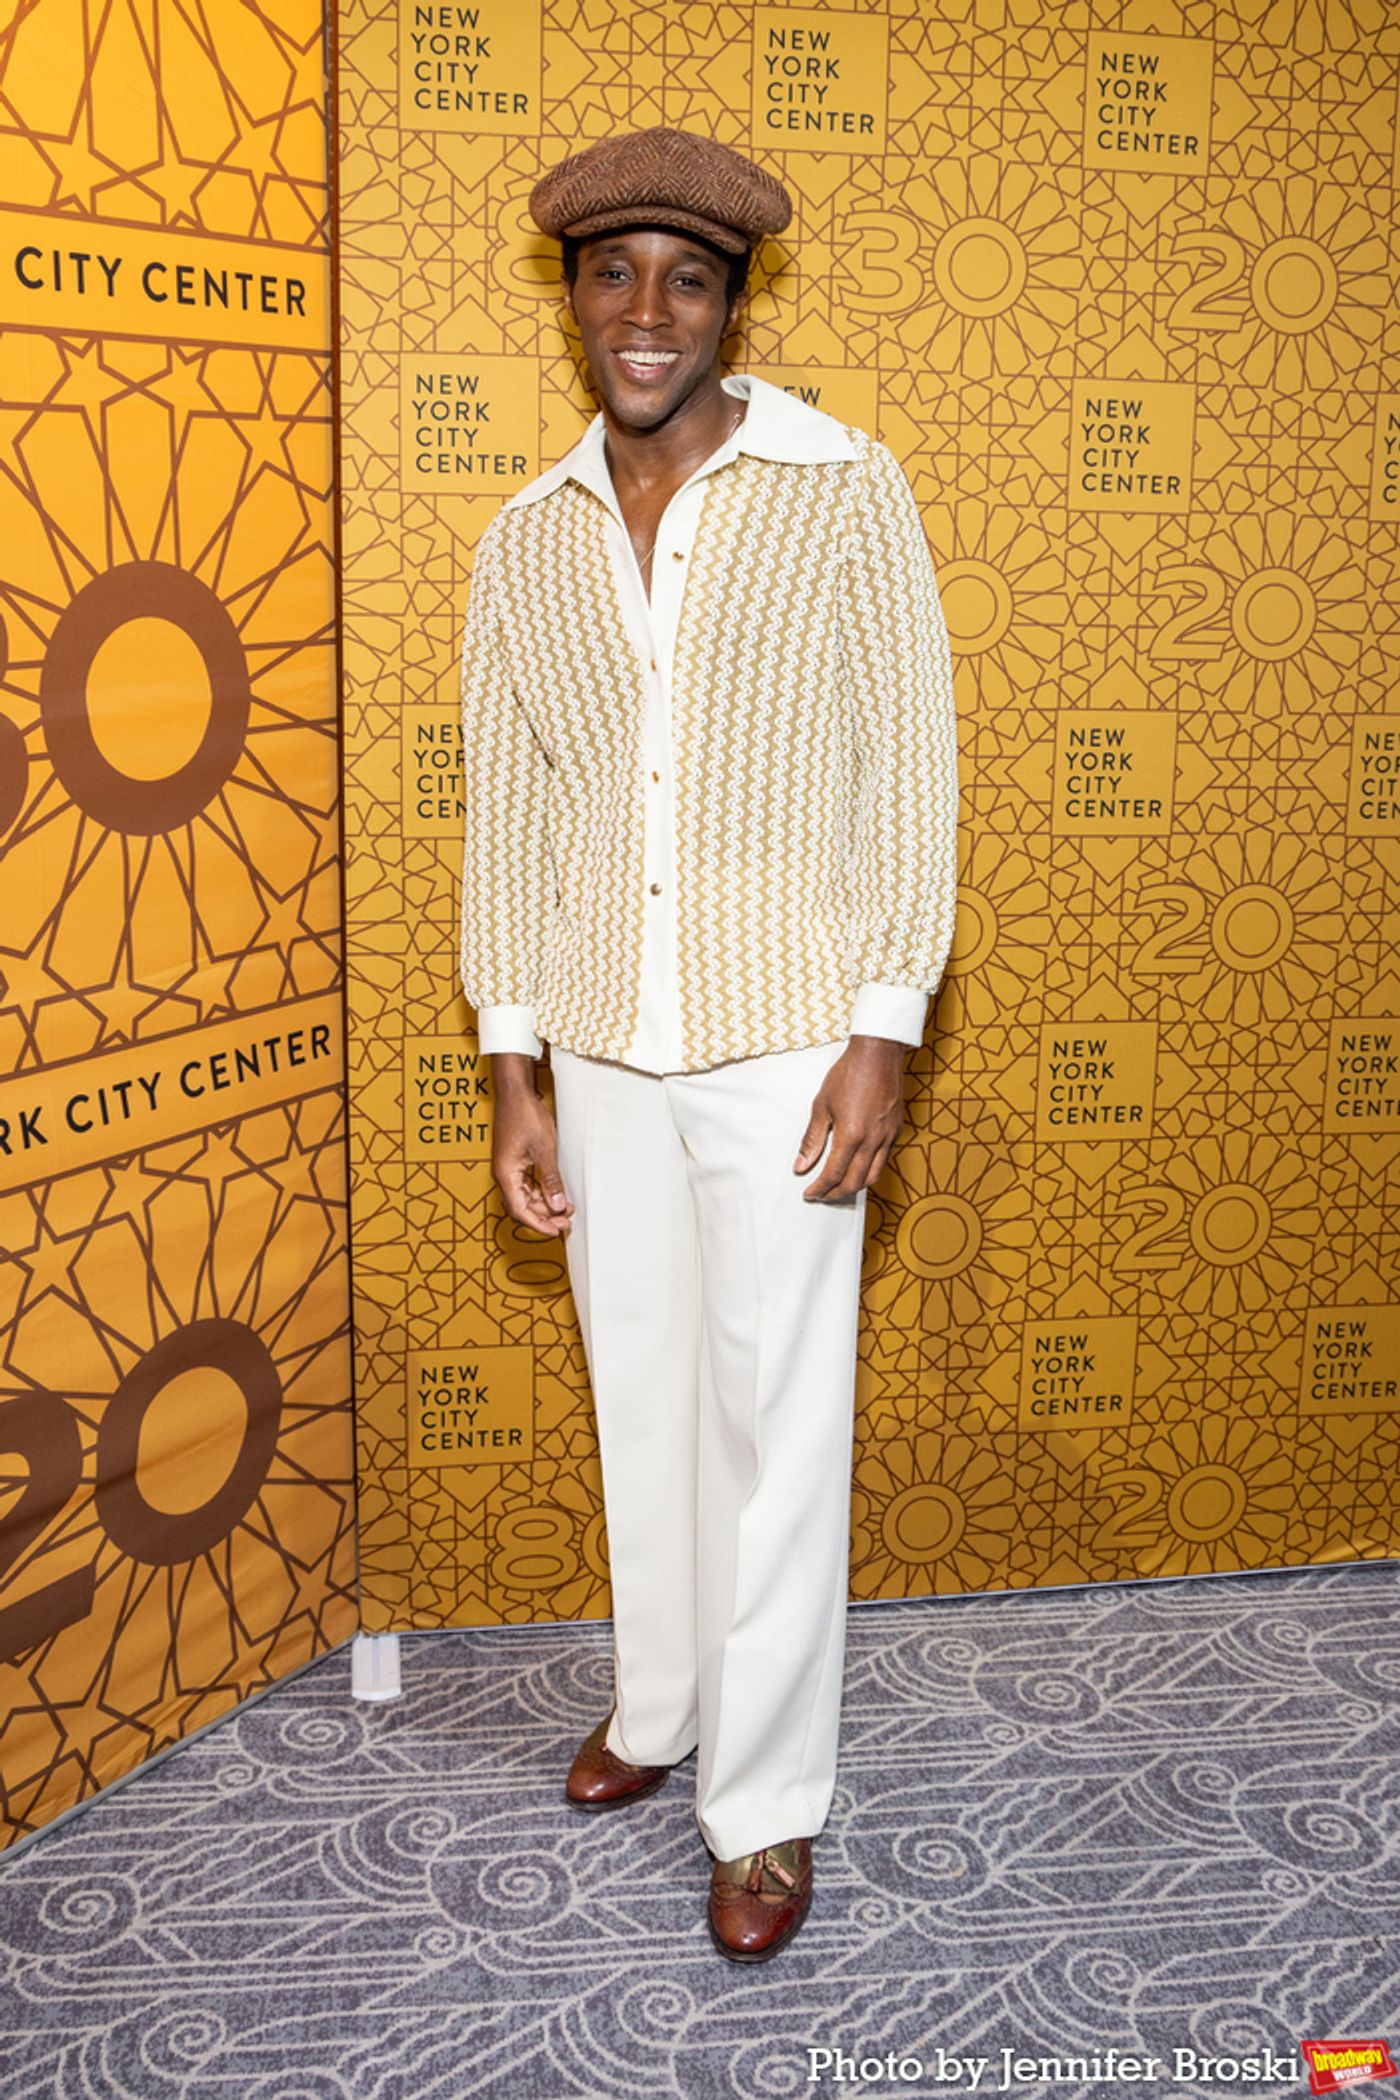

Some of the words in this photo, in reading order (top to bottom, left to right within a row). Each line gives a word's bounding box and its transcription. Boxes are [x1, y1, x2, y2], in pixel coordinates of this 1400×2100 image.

[415, 5, 480, 29] NEW
[410, 33, 491, 58] YORK
[769, 28, 830, 51] NEW
[414, 60, 479, 84] CITY
[764, 54, 840, 79] YORK
[1101, 52, 1159, 75] NEW
[767, 81, 828, 104] CITY
[1096, 77, 1168, 102] YORK
[414, 88, 528, 114] CENTER
[766, 108, 875, 134] CENTER
[1098, 103, 1156, 127] CITY
[1097, 129, 1199, 156] CENTER
[15, 246, 122, 297] CITY
[142, 262, 305, 317] CENTER
[416, 374, 479, 395] NEW
[412, 400, 490, 422] YORK
[1085, 399, 1143, 419] NEW
[415, 426, 478, 448] CITY
[1081, 423, 1150, 445] YORK
[415, 452, 527, 475] CENTER
[1082, 447, 1140, 469] CITY
[1081, 472, 1180, 495] CENTER
[1070, 728, 1125, 748] NEW
[1365, 732, 1400, 751] NE
[1065, 752, 1133, 771] YORK
[416, 773, 466, 794] CIT
[1066, 775, 1122, 795] CITY
[1361, 778, 1397, 797] CIT
[416, 799, 468, 819] CEN
[1065, 799, 1162, 818] CENTER
[1359, 801, 1400, 820] CEN
[1053, 1039, 1107, 1058] NEW
[1341, 1035, 1392, 1052] NEW
[419, 1053, 479, 1073] NEW
[1049, 1062, 1115, 1080] YORK
[1337, 1056, 1398, 1074] YORK
[65, 1072, 161, 1133] CITY
[179, 1023, 332, 1099] CENTER
[414, 1076, 490, 1097] YORK
[1337, 1077, 1388, 1096] CITY
[1049, 1084, 1104, 1103] CITY
[418, 1100, 478, 1121] CITY
[1048, 1105, 1143, 1125] CENTER
[1335, 1099, 1400, 1118] CENT
[418, 1123, 489, 1144] CENT
[1317, 1322, 1367, 1339] NEW
[1035, 1335, 1088, 1353] NEW
[1312, 1341, 1373, 1359] YORK
[421, 1365, 479, 1385] NEW
[1031, 1355, 1095, 1374] YORK
[1312, 1362, 1362, 1380] CITY
[417, 1386, 489, 1407] YORK
[1032, 1376, 1085, 1396] CITY
[1311, 1380, 1398, 1400] CENTER
[1030, 1394, 1124, 1417] CENTER
[420, 1409, 478, 1429] CITY
[420, 1427, 523, 1451] CENTER
